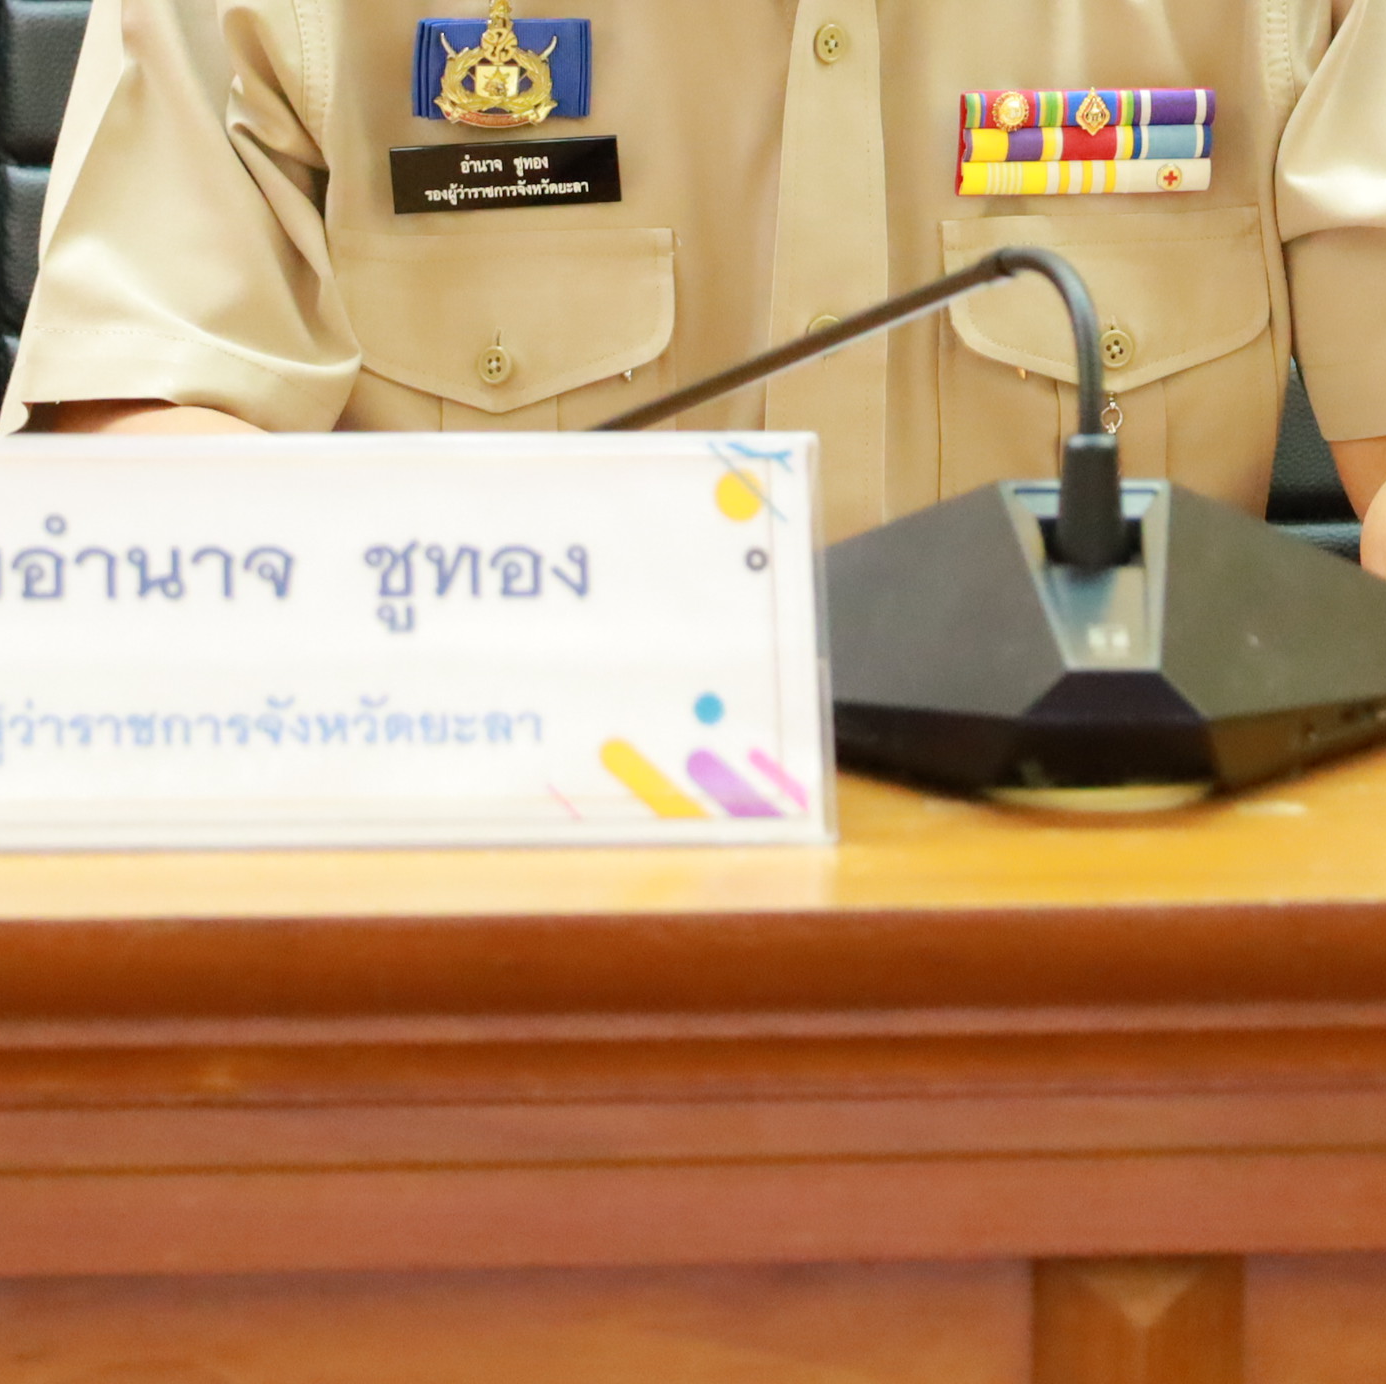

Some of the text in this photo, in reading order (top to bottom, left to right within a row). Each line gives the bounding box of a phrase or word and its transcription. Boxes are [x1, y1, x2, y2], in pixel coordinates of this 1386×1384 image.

[460, 155, 549, 177] อำนาจ ชูทอง
[425, 178, 589, 205] รองผู้ว่าราชการจังหวัดยะลา
[362, 538, 591, 633] ชูทอง
